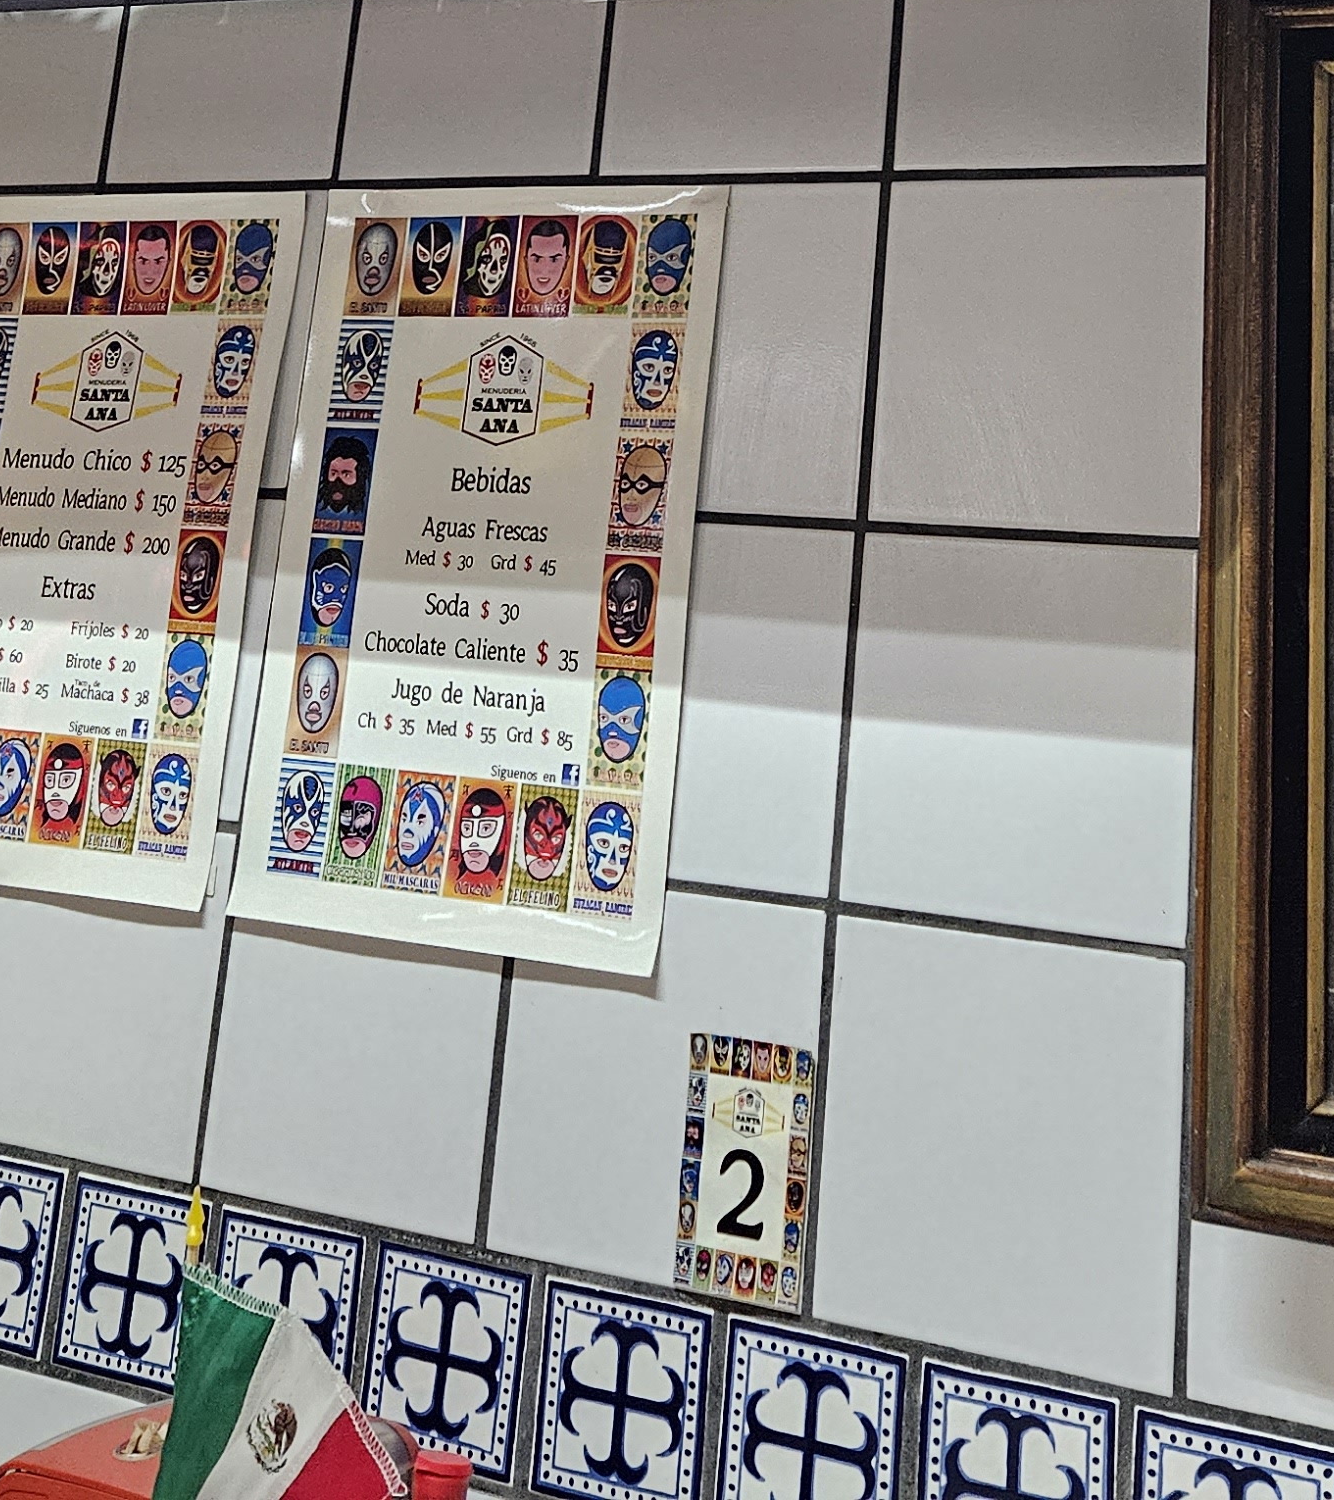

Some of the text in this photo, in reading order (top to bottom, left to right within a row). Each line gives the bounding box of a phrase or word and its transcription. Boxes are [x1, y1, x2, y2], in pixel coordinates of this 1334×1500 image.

[79, 388, 131, 403] SANTA
[480, 387, 527, 395] MENUDERIA
[84, 407, 118, 422] ANA
[470, 397, 533, 415] SANTA
[478, 419, 520, 435] ANA
[2, 447, 188, 478] Menudo Chico $ 125
[450, 466, 533, 496] Bebidas
[61, 488, 127, 511] Mediano
[134, 488, 146, 513] $
[152, 494, 177, 518] 150
[57, 529, 116, 553] Grande
[123, 530, 136, 555] $
[142, 537, 171, 556] 200
[421, 516, 549, 545] Aguas Frescas
[405, 549, 558, 578] Med $ 30 Grd $ 45
[41, 575, 97, 601] Extras
[424, 591, 521, 625] Soda $ 30
[8, 615, 16, 631] $
[20, 618, 34, 632] 20
[70, 620, 150, 641] Frijoles $ 20
[8, 649, 23, 664] 60
[66, 653, 137, 673] Birote $ 20
[364, 630, 580, 673] Chocolate Caliente $ 35
[22, 679, 30, 695] $
[34, 683, 50, 700] 25
[60, 682, 150, 708] Machaca $ 38
[391, 678, 547, 718] Jugo de Naranja
[115, 727, 127, 738] en
[357, 711, 574, 752] Ch $ 35 Med $ 55 Grd $ 85
[543, 771, 557, 784] en
[716, 1148, 765, 1241] 2
